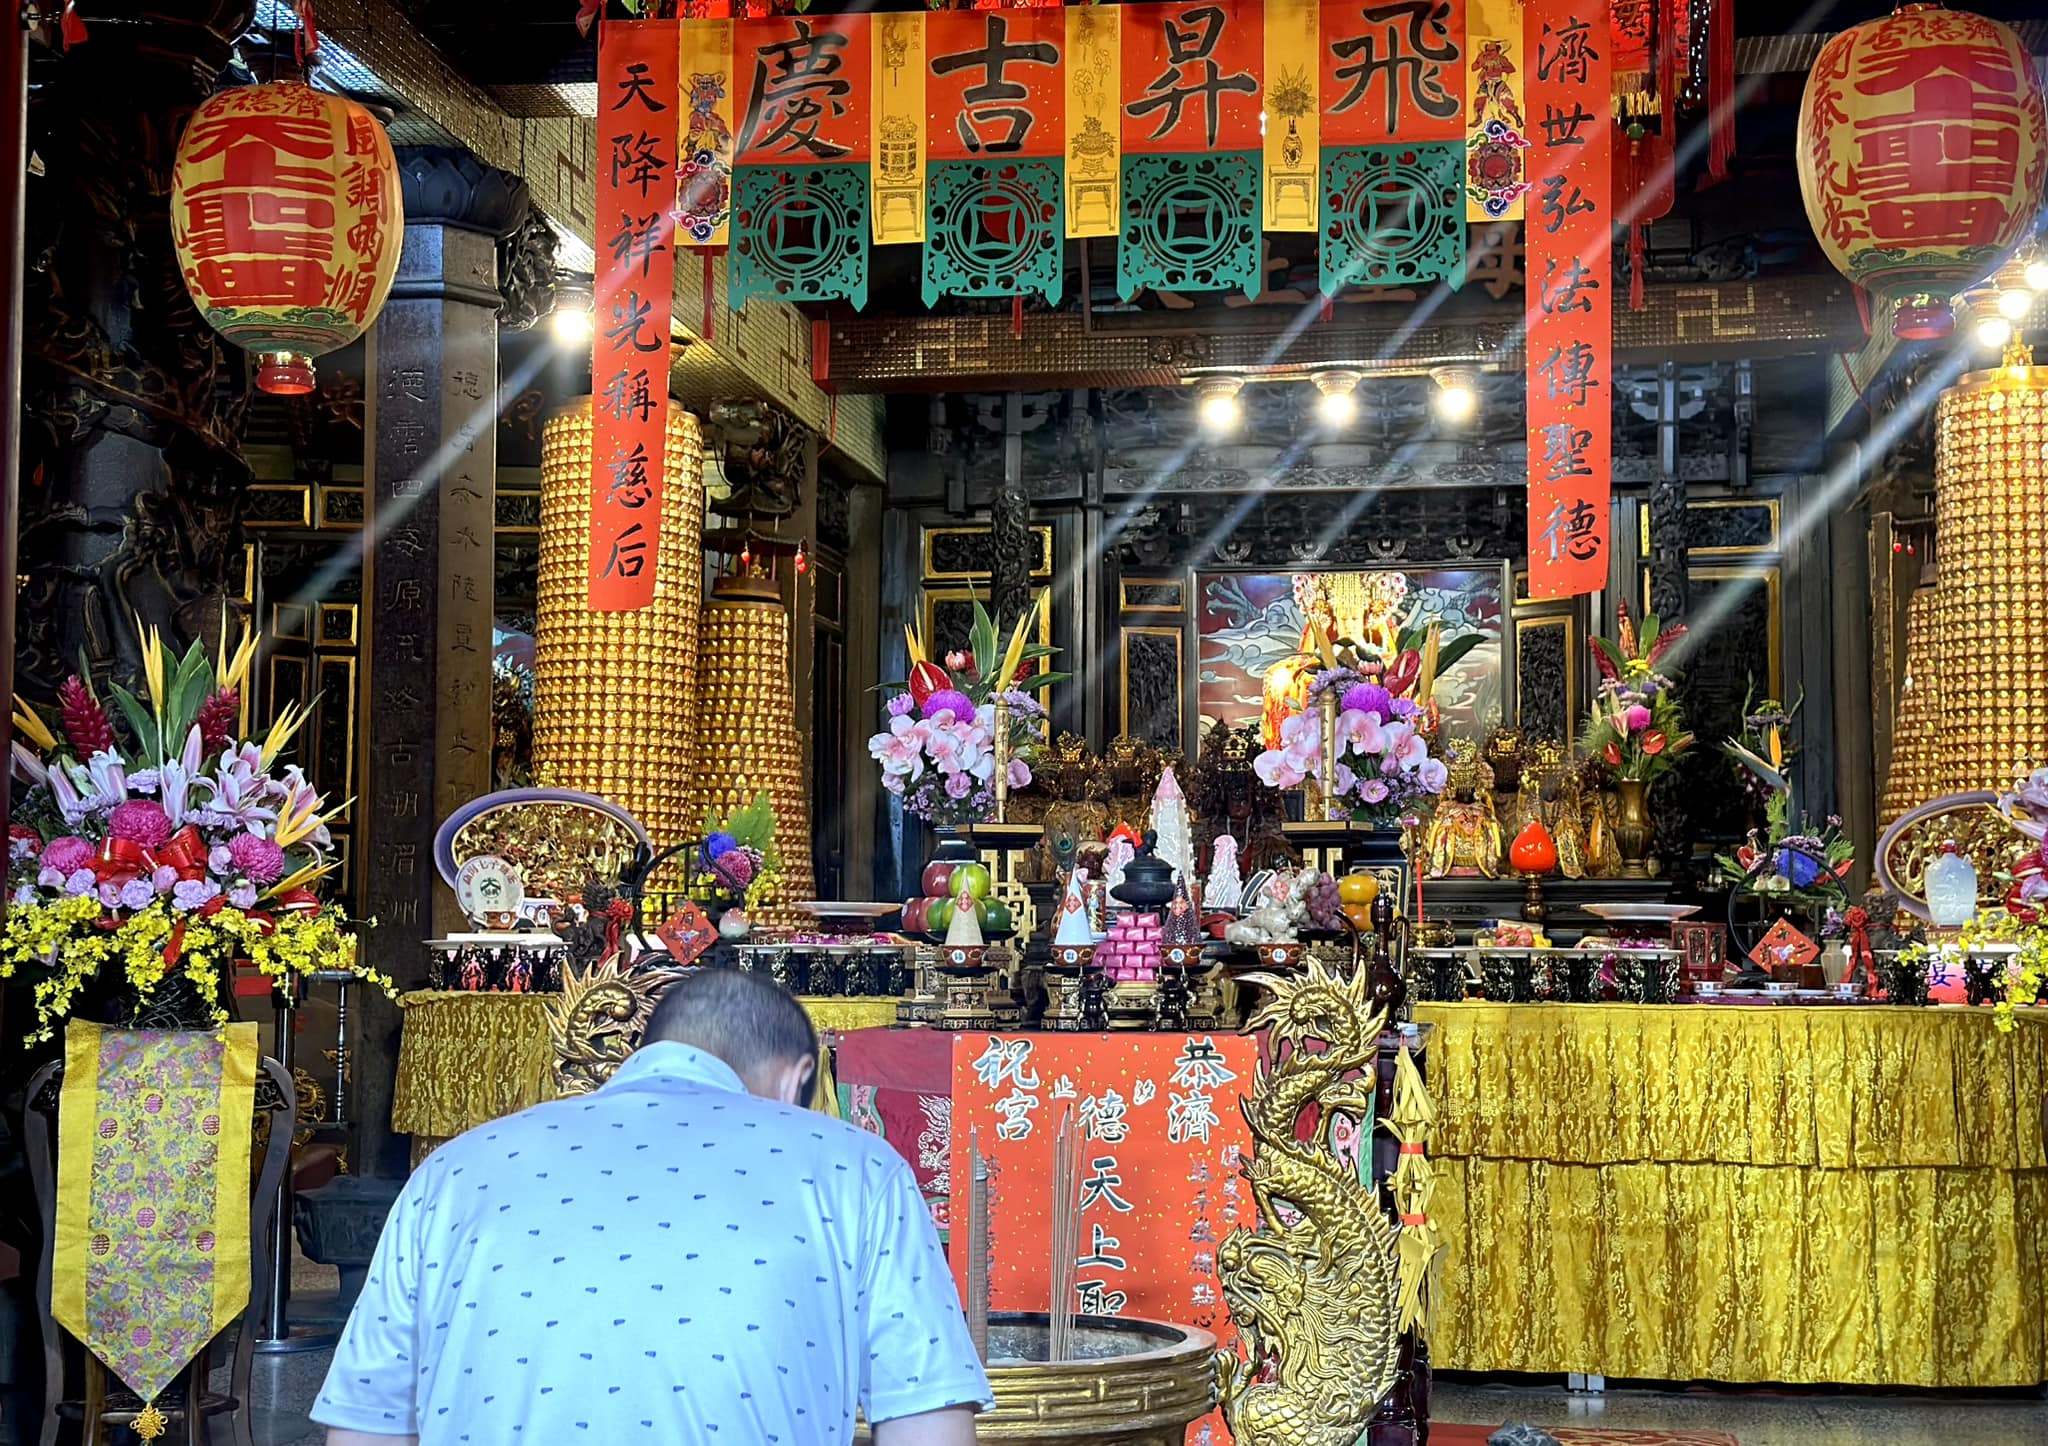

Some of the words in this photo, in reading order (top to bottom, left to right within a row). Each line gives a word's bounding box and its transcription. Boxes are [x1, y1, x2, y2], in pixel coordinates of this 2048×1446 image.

[182, 114, 336, 309] 天上聖母
[324, 113, 392, 325] 風調雨順
[1853, 44, 2022, 251] 天上聖母
[601, 62, 670, 582] 天降祥光稱慈后
[1537, 14, 1603, 564] 濟世弘法傳聖德
